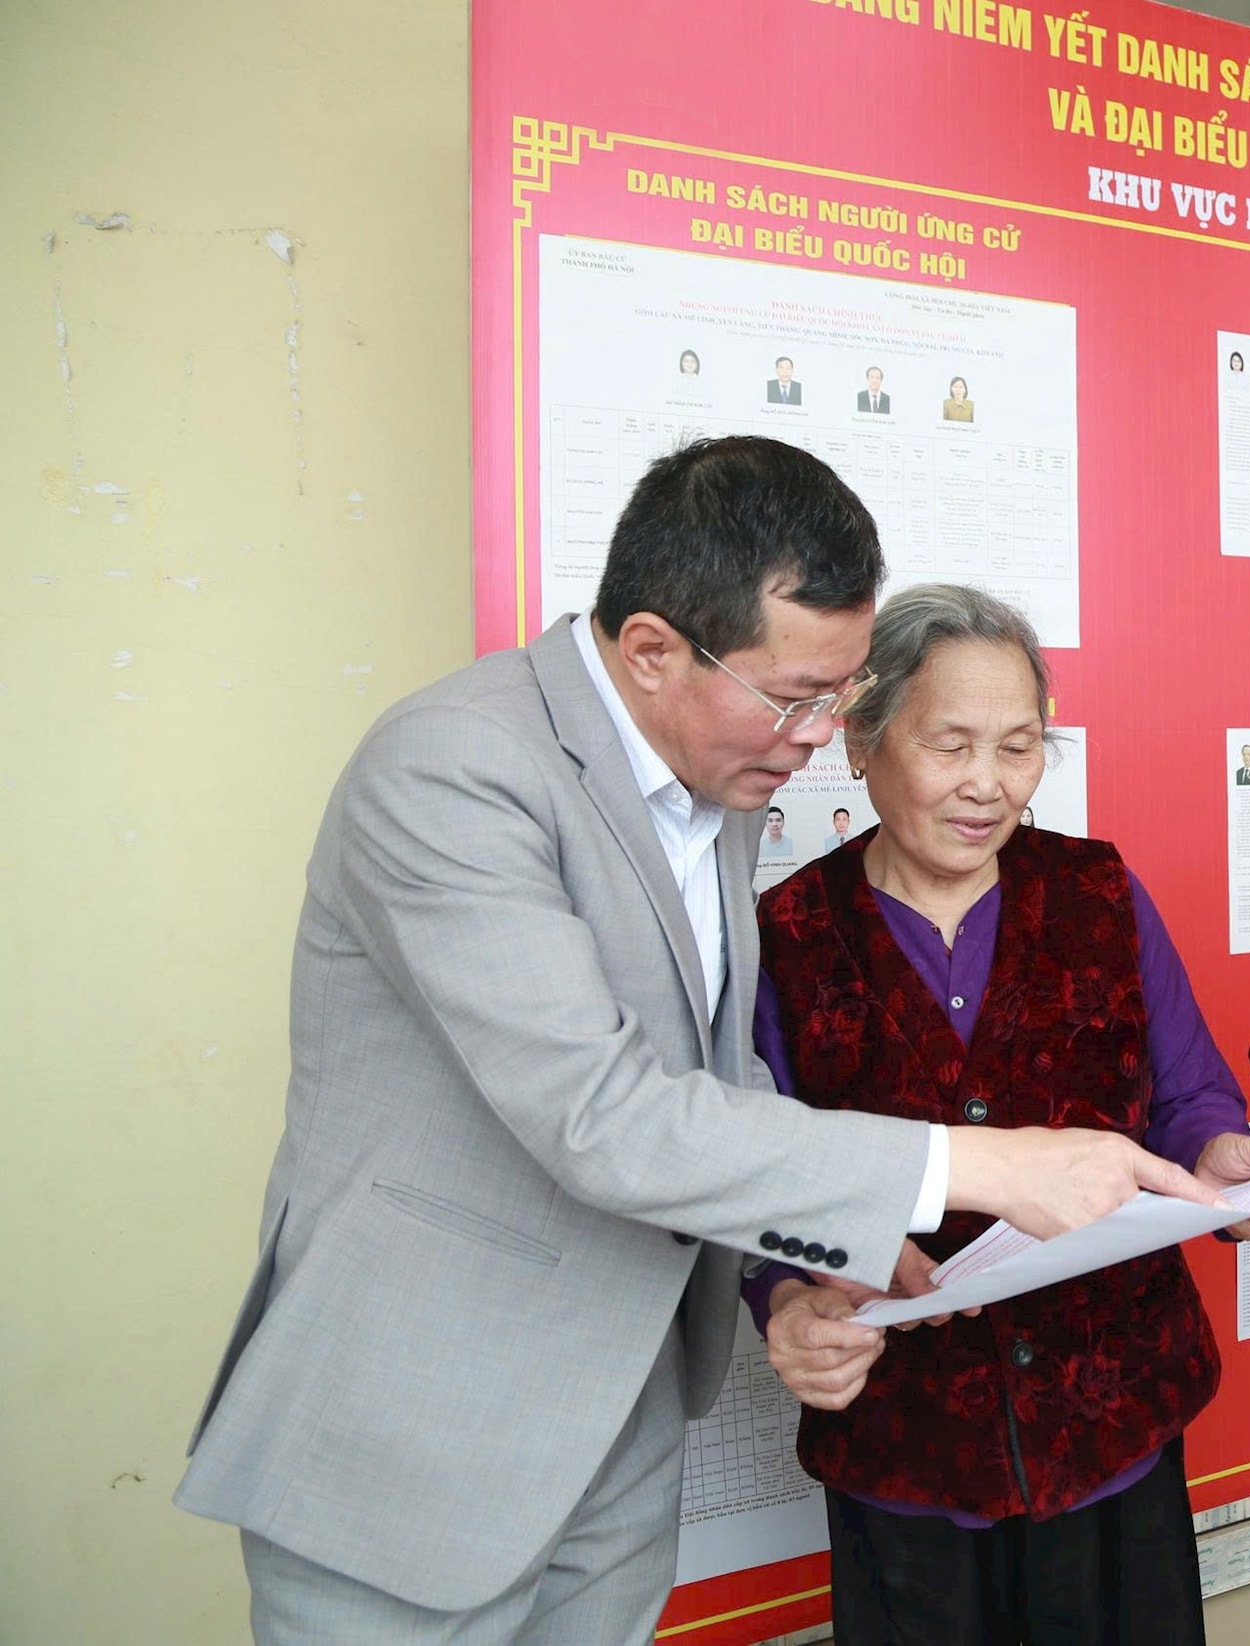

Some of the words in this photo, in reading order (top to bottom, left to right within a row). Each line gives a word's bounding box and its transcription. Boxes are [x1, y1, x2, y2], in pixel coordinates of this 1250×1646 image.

[1044, 10, 1106, 67] YẾT
[1118, 33, 1209, 92] DANH
[1048, 86, 1095, 137] VÀ
[1105, 100, 1163, 157] ĐẠI
[1174, 110, 1248, 169] BIỂU
[627, 168, 716, 205] DANH
[726, 183, 809, 219] SÁCH
[817, 199, 909, 235] NGƯỜI
[916, 212, 975, 245] ỨNG
[982, 223, 1022, 252] CỬ
[1088, 166, 1162, 212] KHU
[1171, 182, 1237, 229] VỰC
[690, 217, 744, 250] ĐẠI
[753, 224, 824, 259] BIỂU
[832, 239, 911, 272] QUỐC
[919, 250, 966, 283] HỘI
